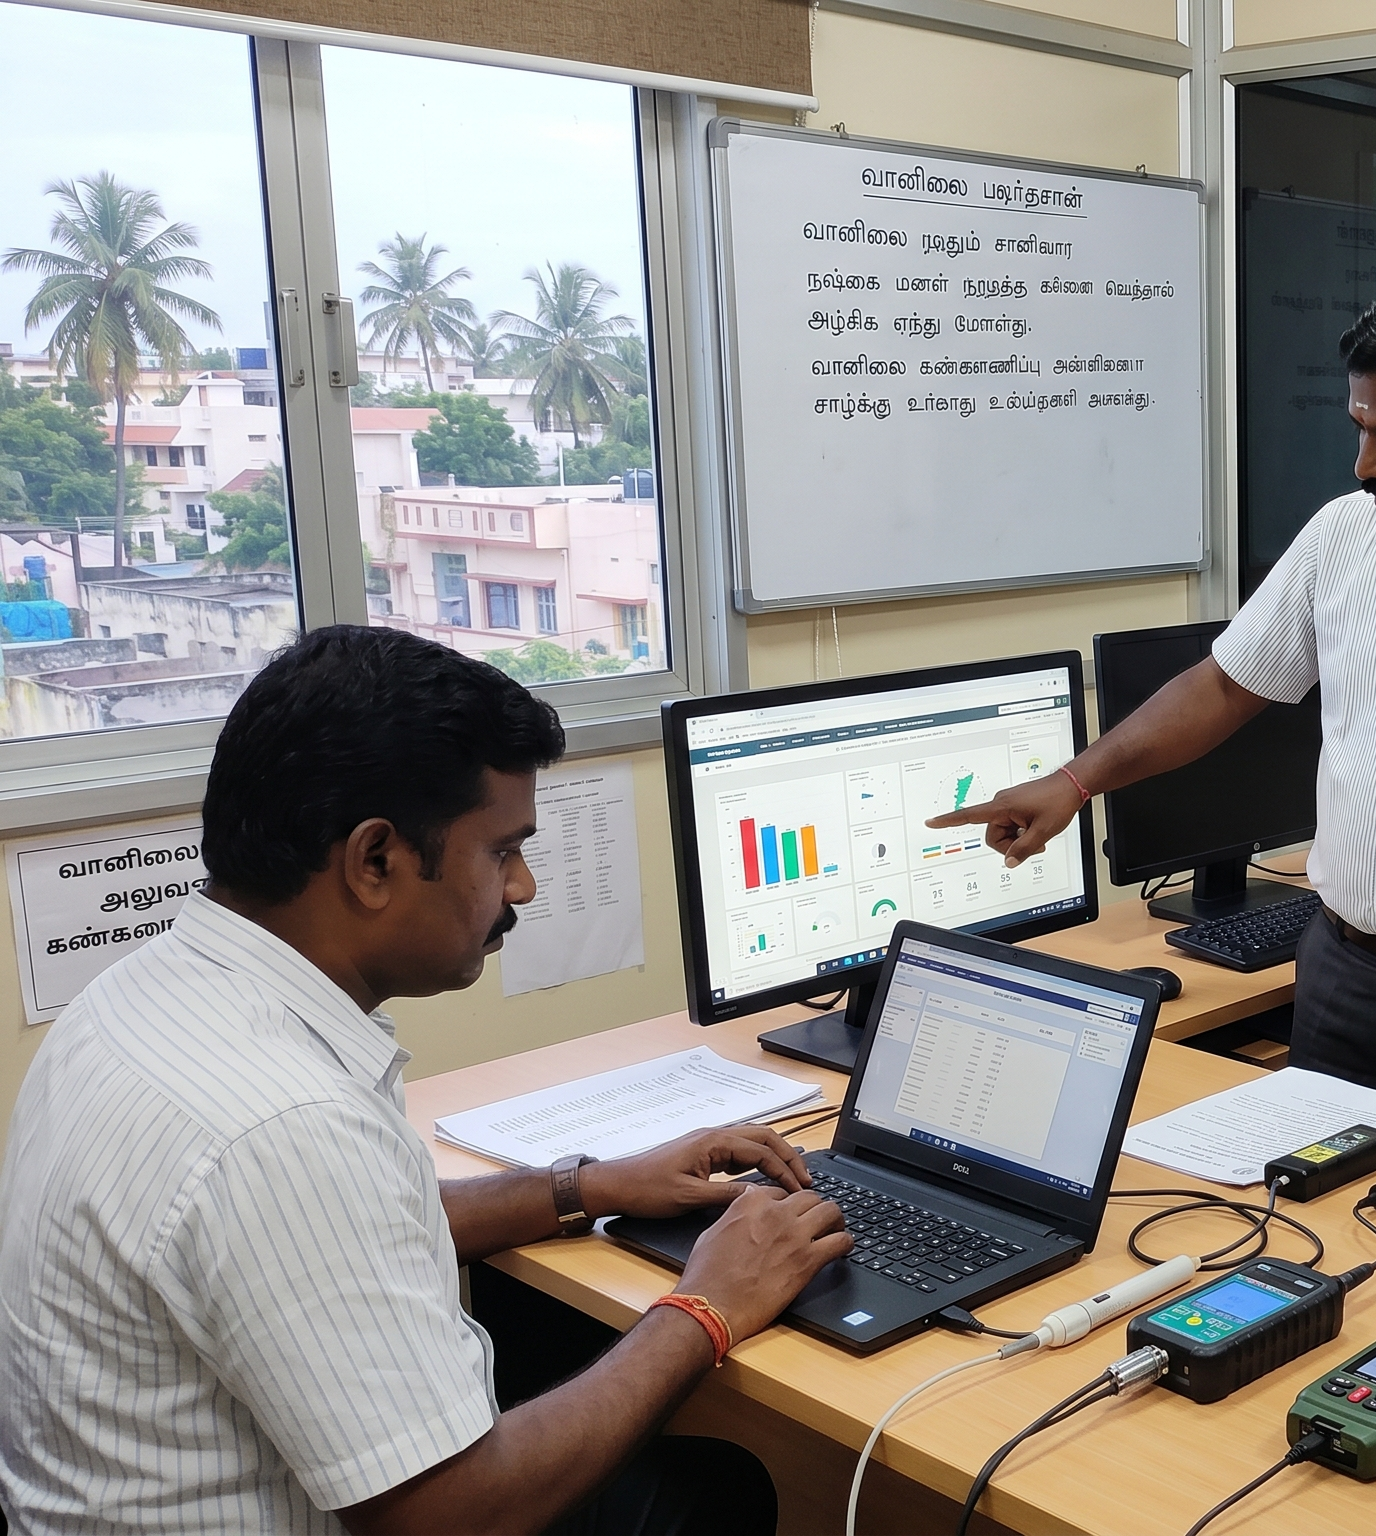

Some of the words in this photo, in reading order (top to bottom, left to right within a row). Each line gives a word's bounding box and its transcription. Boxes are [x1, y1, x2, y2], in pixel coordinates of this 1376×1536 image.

[861, 165, 969, 198] வானிலை
[803, 219, 908, 247] வானிலை
[811, 353, 907, 376] வானிலை
[58, 844, 200, 879] வானிலை
